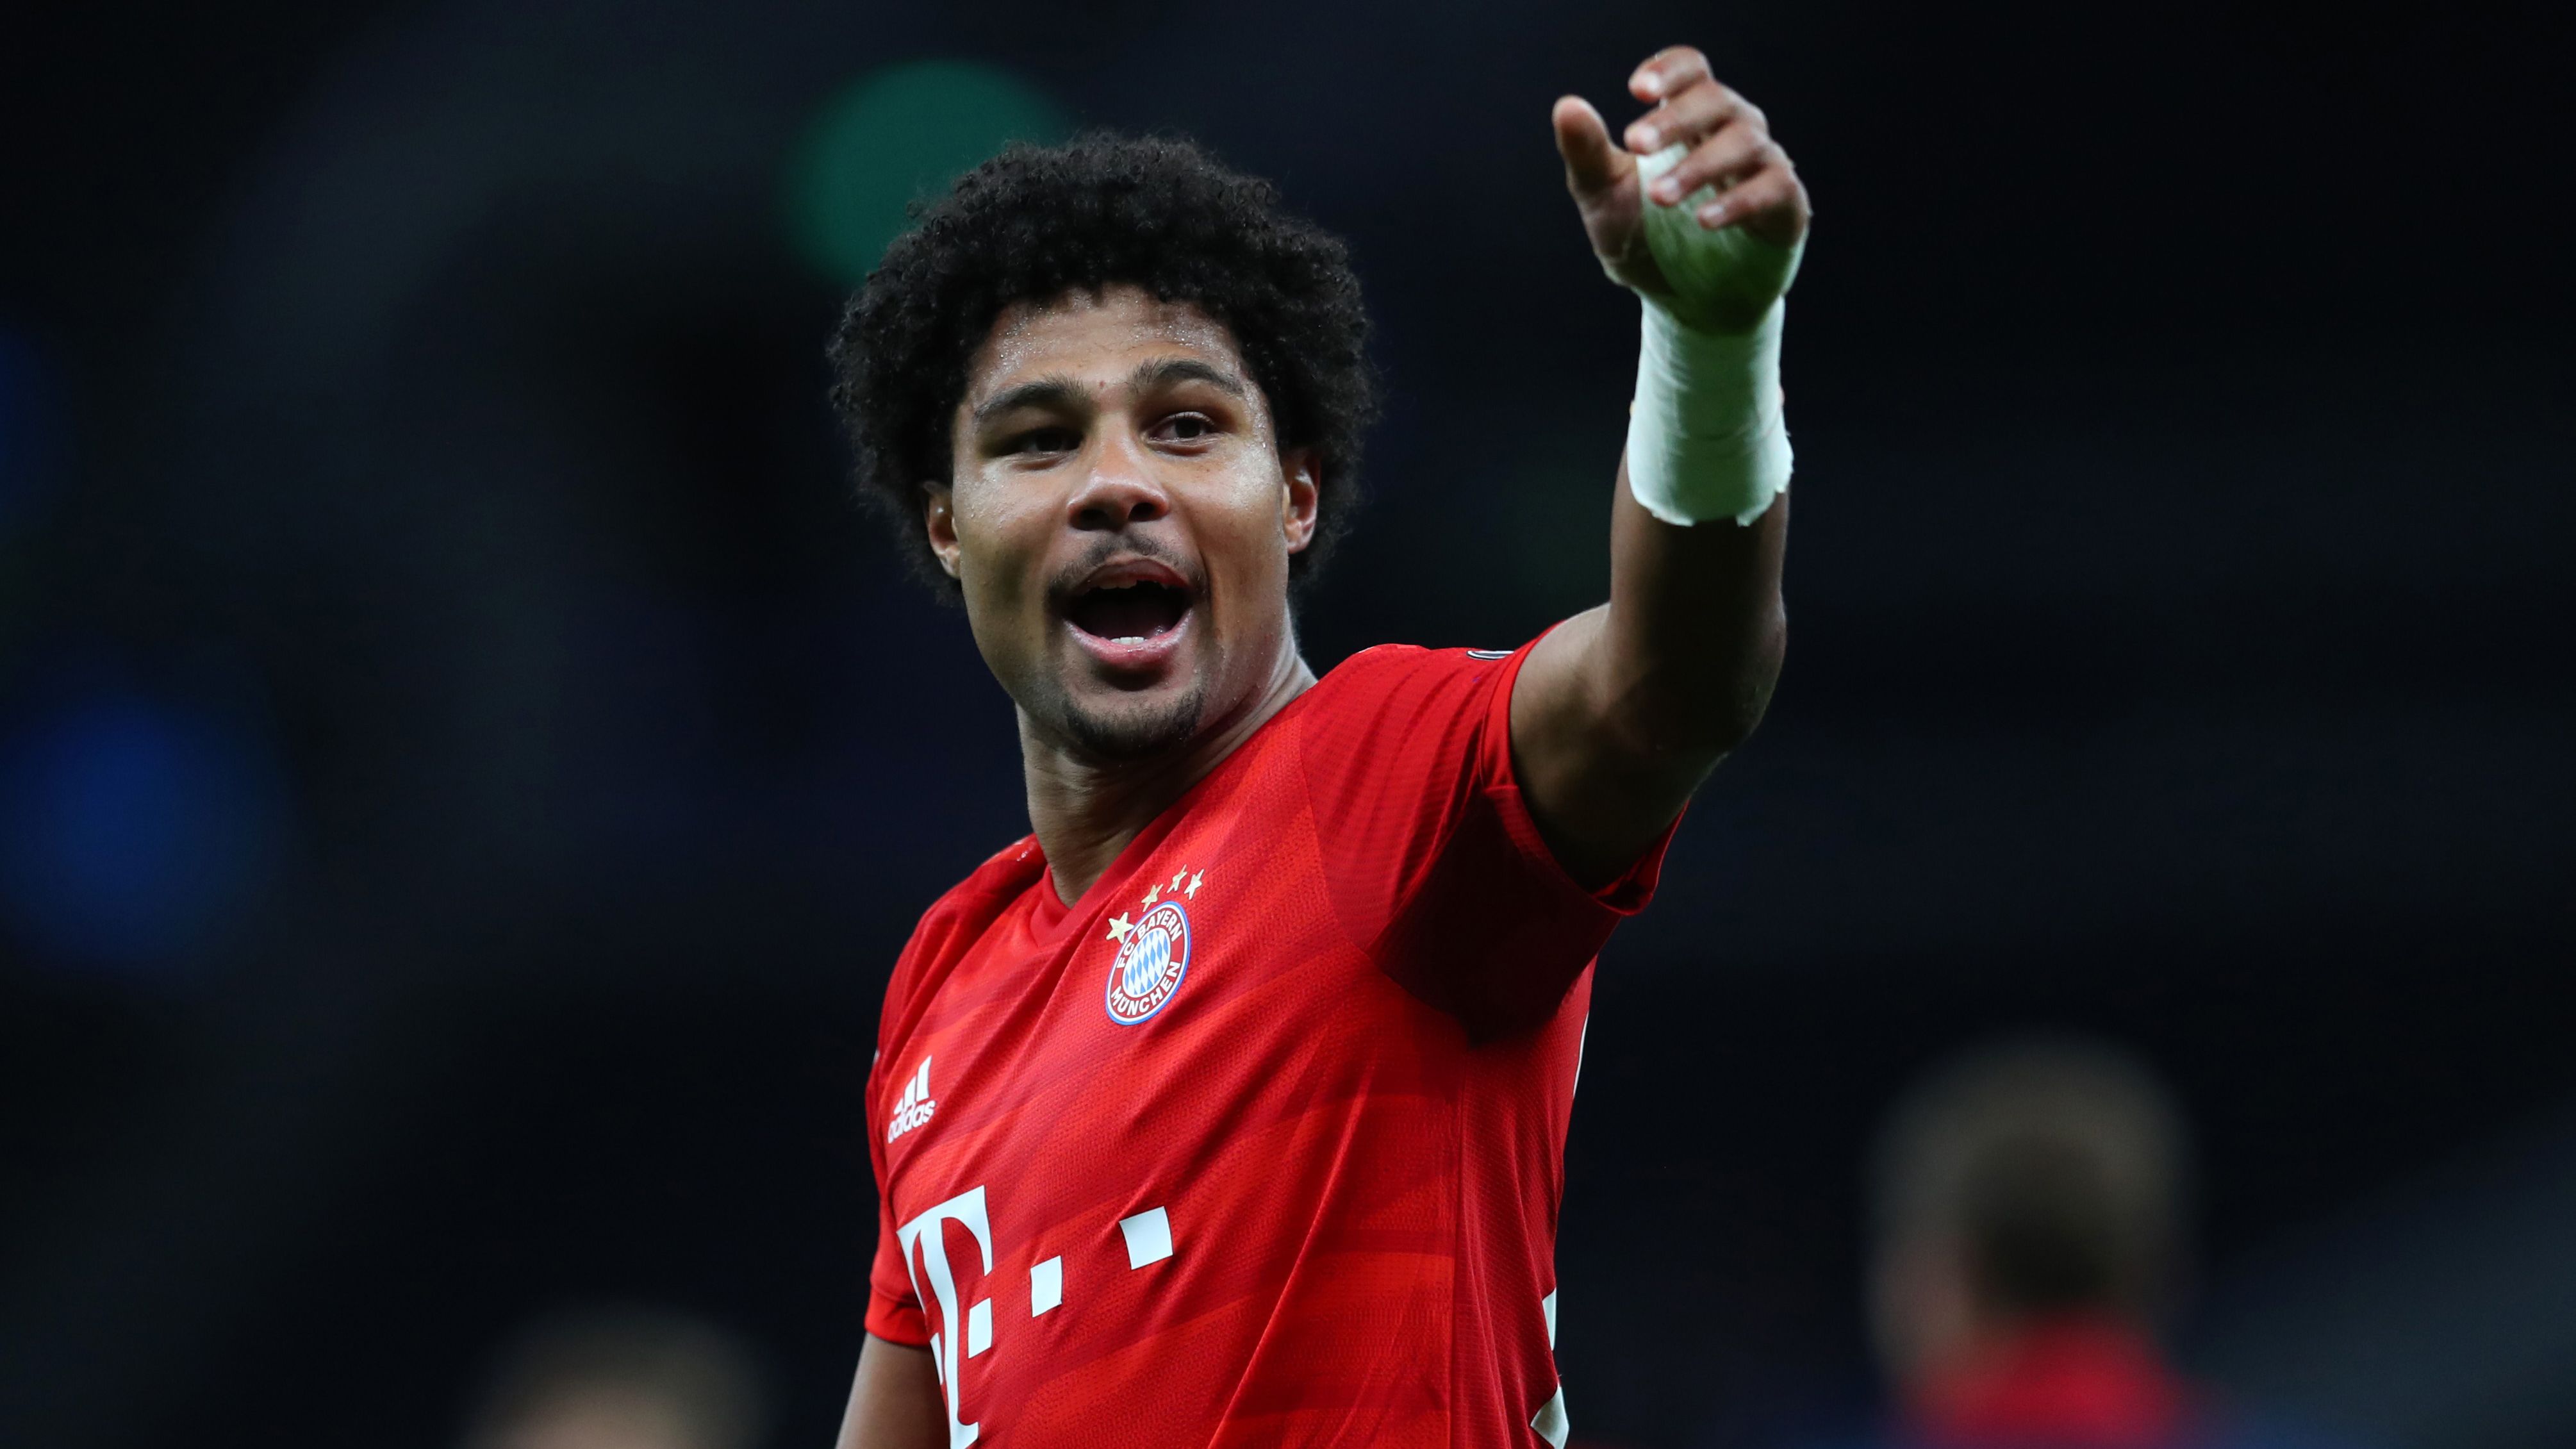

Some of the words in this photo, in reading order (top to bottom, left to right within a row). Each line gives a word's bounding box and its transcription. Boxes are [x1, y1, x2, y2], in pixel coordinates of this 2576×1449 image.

[1116, 941, 1135, 968] FC
[1137, 910, 1182, 941] BAYERN
[1110, 961, 1180, 1015] MÜNCHEN
[888, 1100, 936, 1144] adidas
